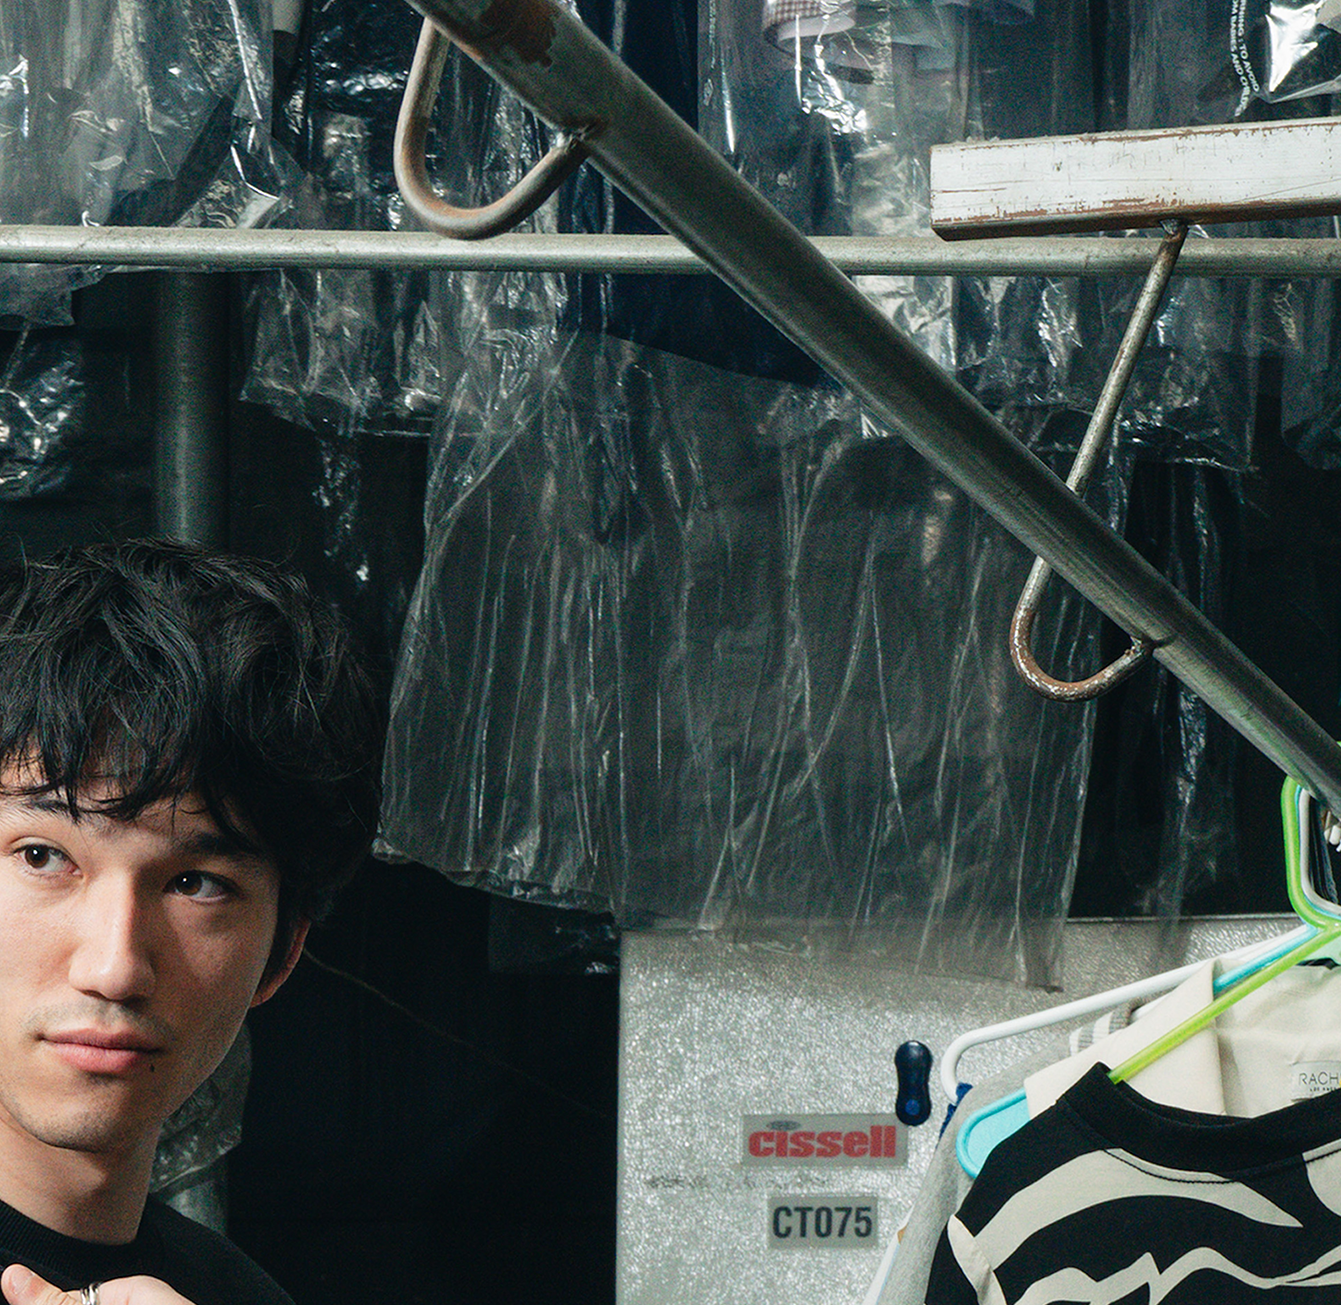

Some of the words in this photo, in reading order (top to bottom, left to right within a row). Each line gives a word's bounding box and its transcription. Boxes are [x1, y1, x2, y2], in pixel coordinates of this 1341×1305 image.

[1231, 53, 1244, 76] AND
[1239, 44, 1248, 60] TO
[1242, 60, 1260, 92] AVOID
[748, 1125, 896, 1158] cissell
[772, 1206, 873, 1239] CT075
